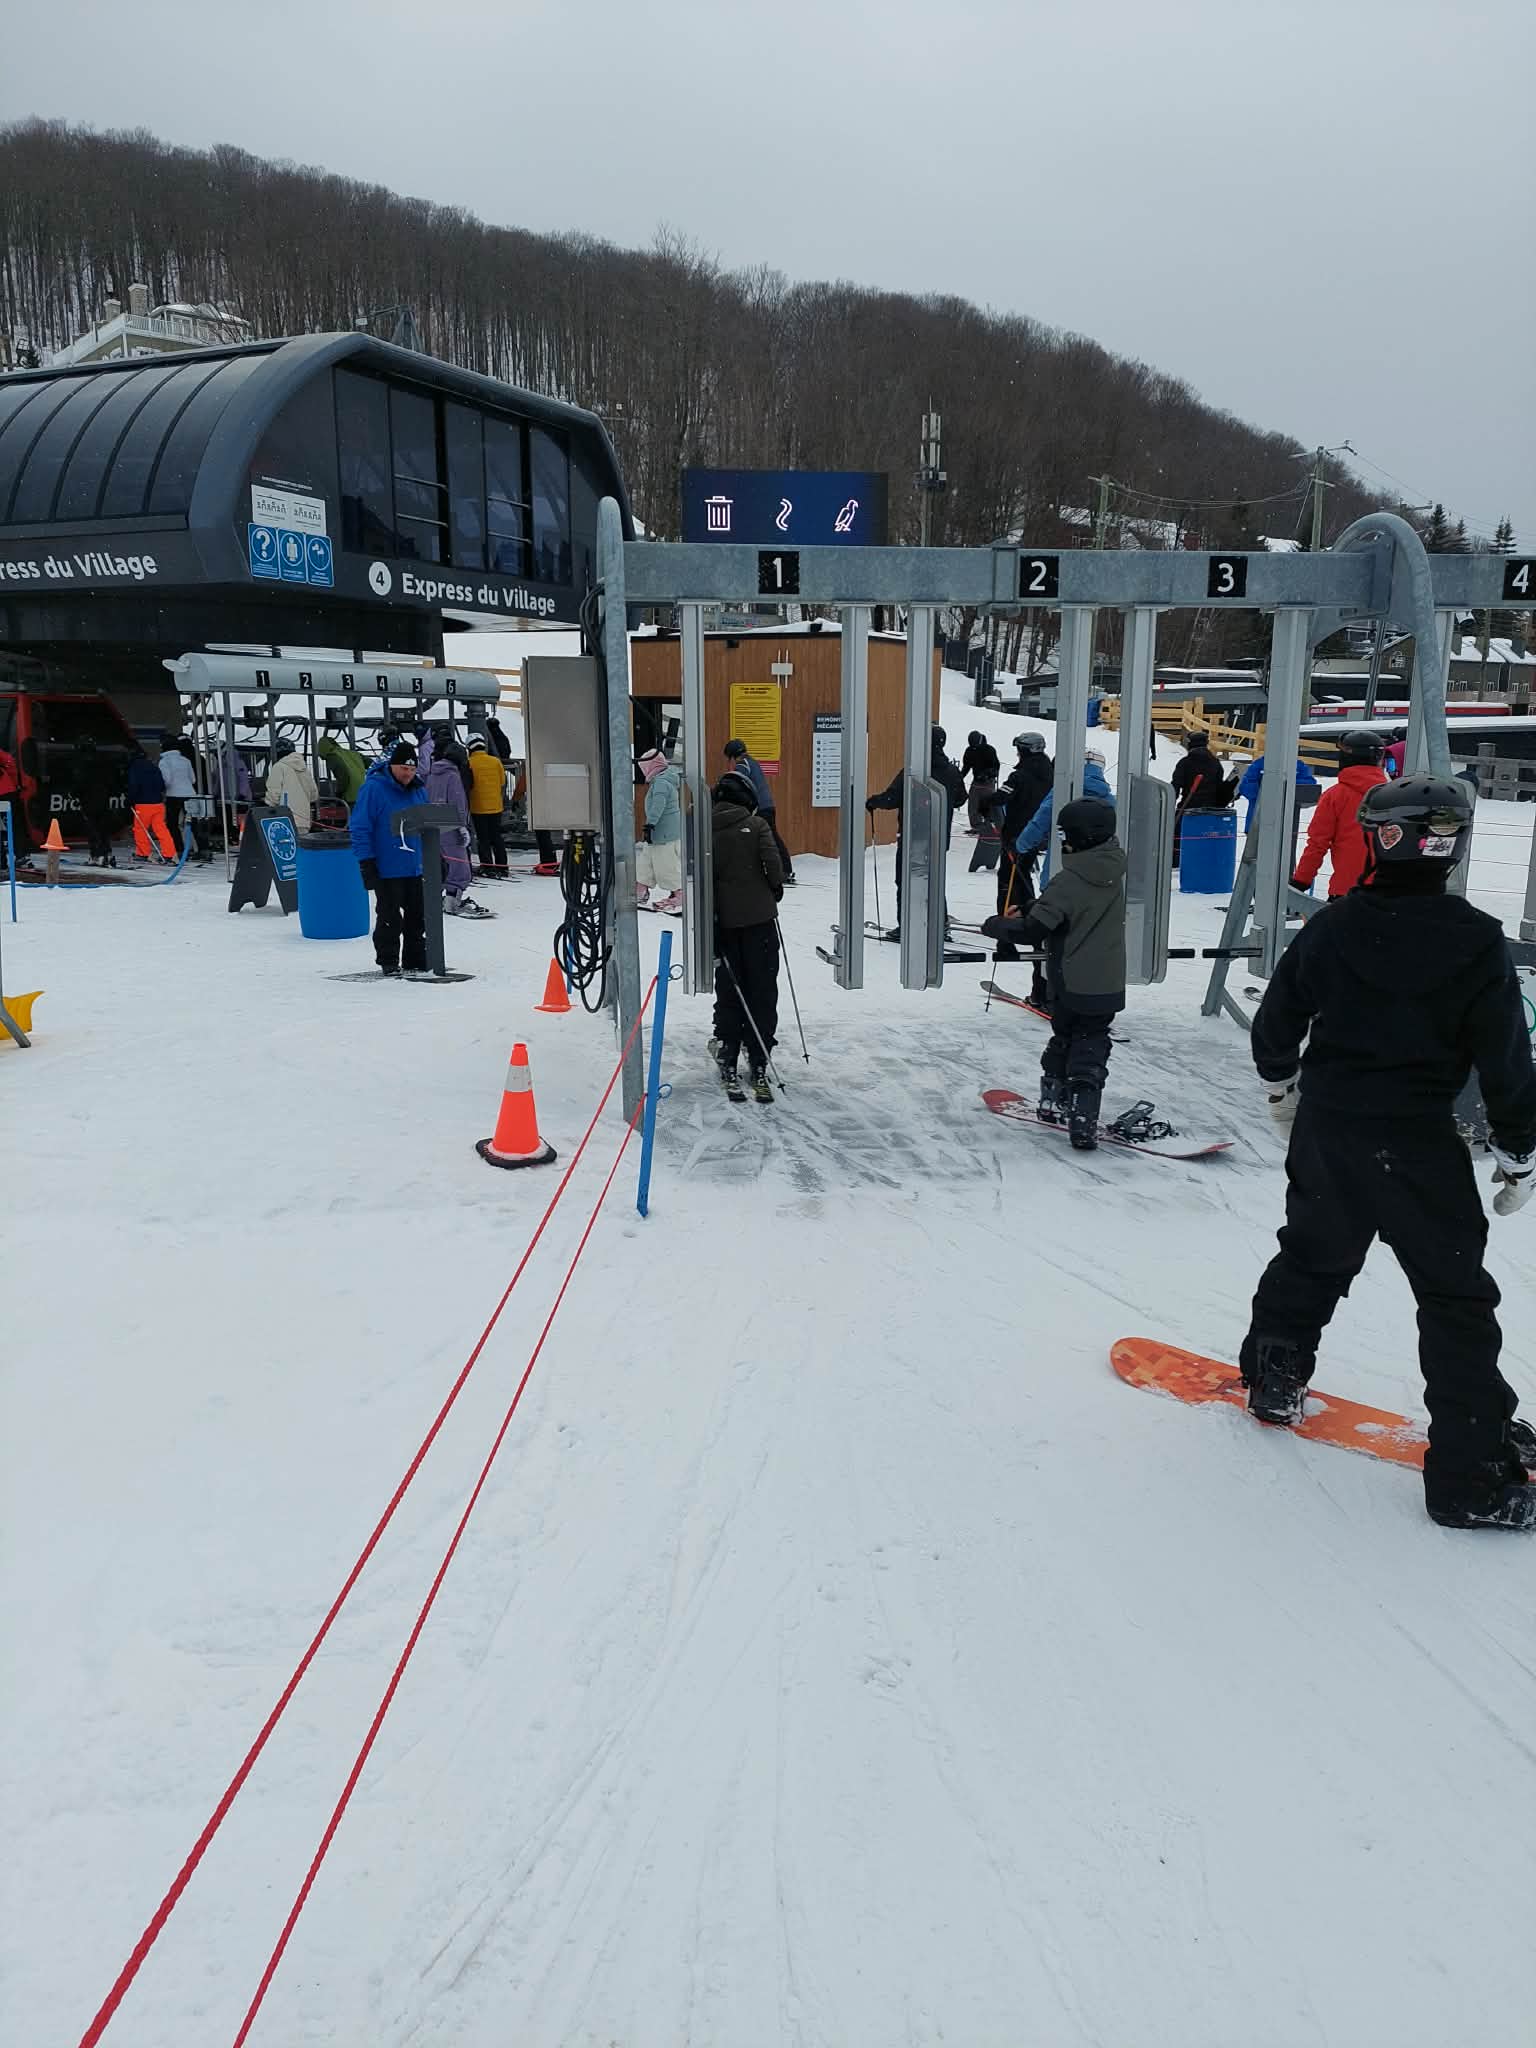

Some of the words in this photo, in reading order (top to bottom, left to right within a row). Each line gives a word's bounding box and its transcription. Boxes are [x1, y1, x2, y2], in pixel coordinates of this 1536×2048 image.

[44, 555, 74, 578] du
[73, 552, 158, 580] Village
[773, 557, 782, 588] 1
[1029, 561, 1047, 591] 2
[1216, 562, 1234, 593] 3
[1512, 564, 1529, 593] 4
[375, 571, 385, 586] 4
[402, 572, 473, 602] Express
[477, 584, 499, 605] du
[502, 586, 556, 617] Village
[303, 674, 310, 688] 2
[345, 676, 351, 689] 3
[379, 677, 385, 690] 4
[415, 679, 421, 692] 5
[448, 680, 454, 693] 6
